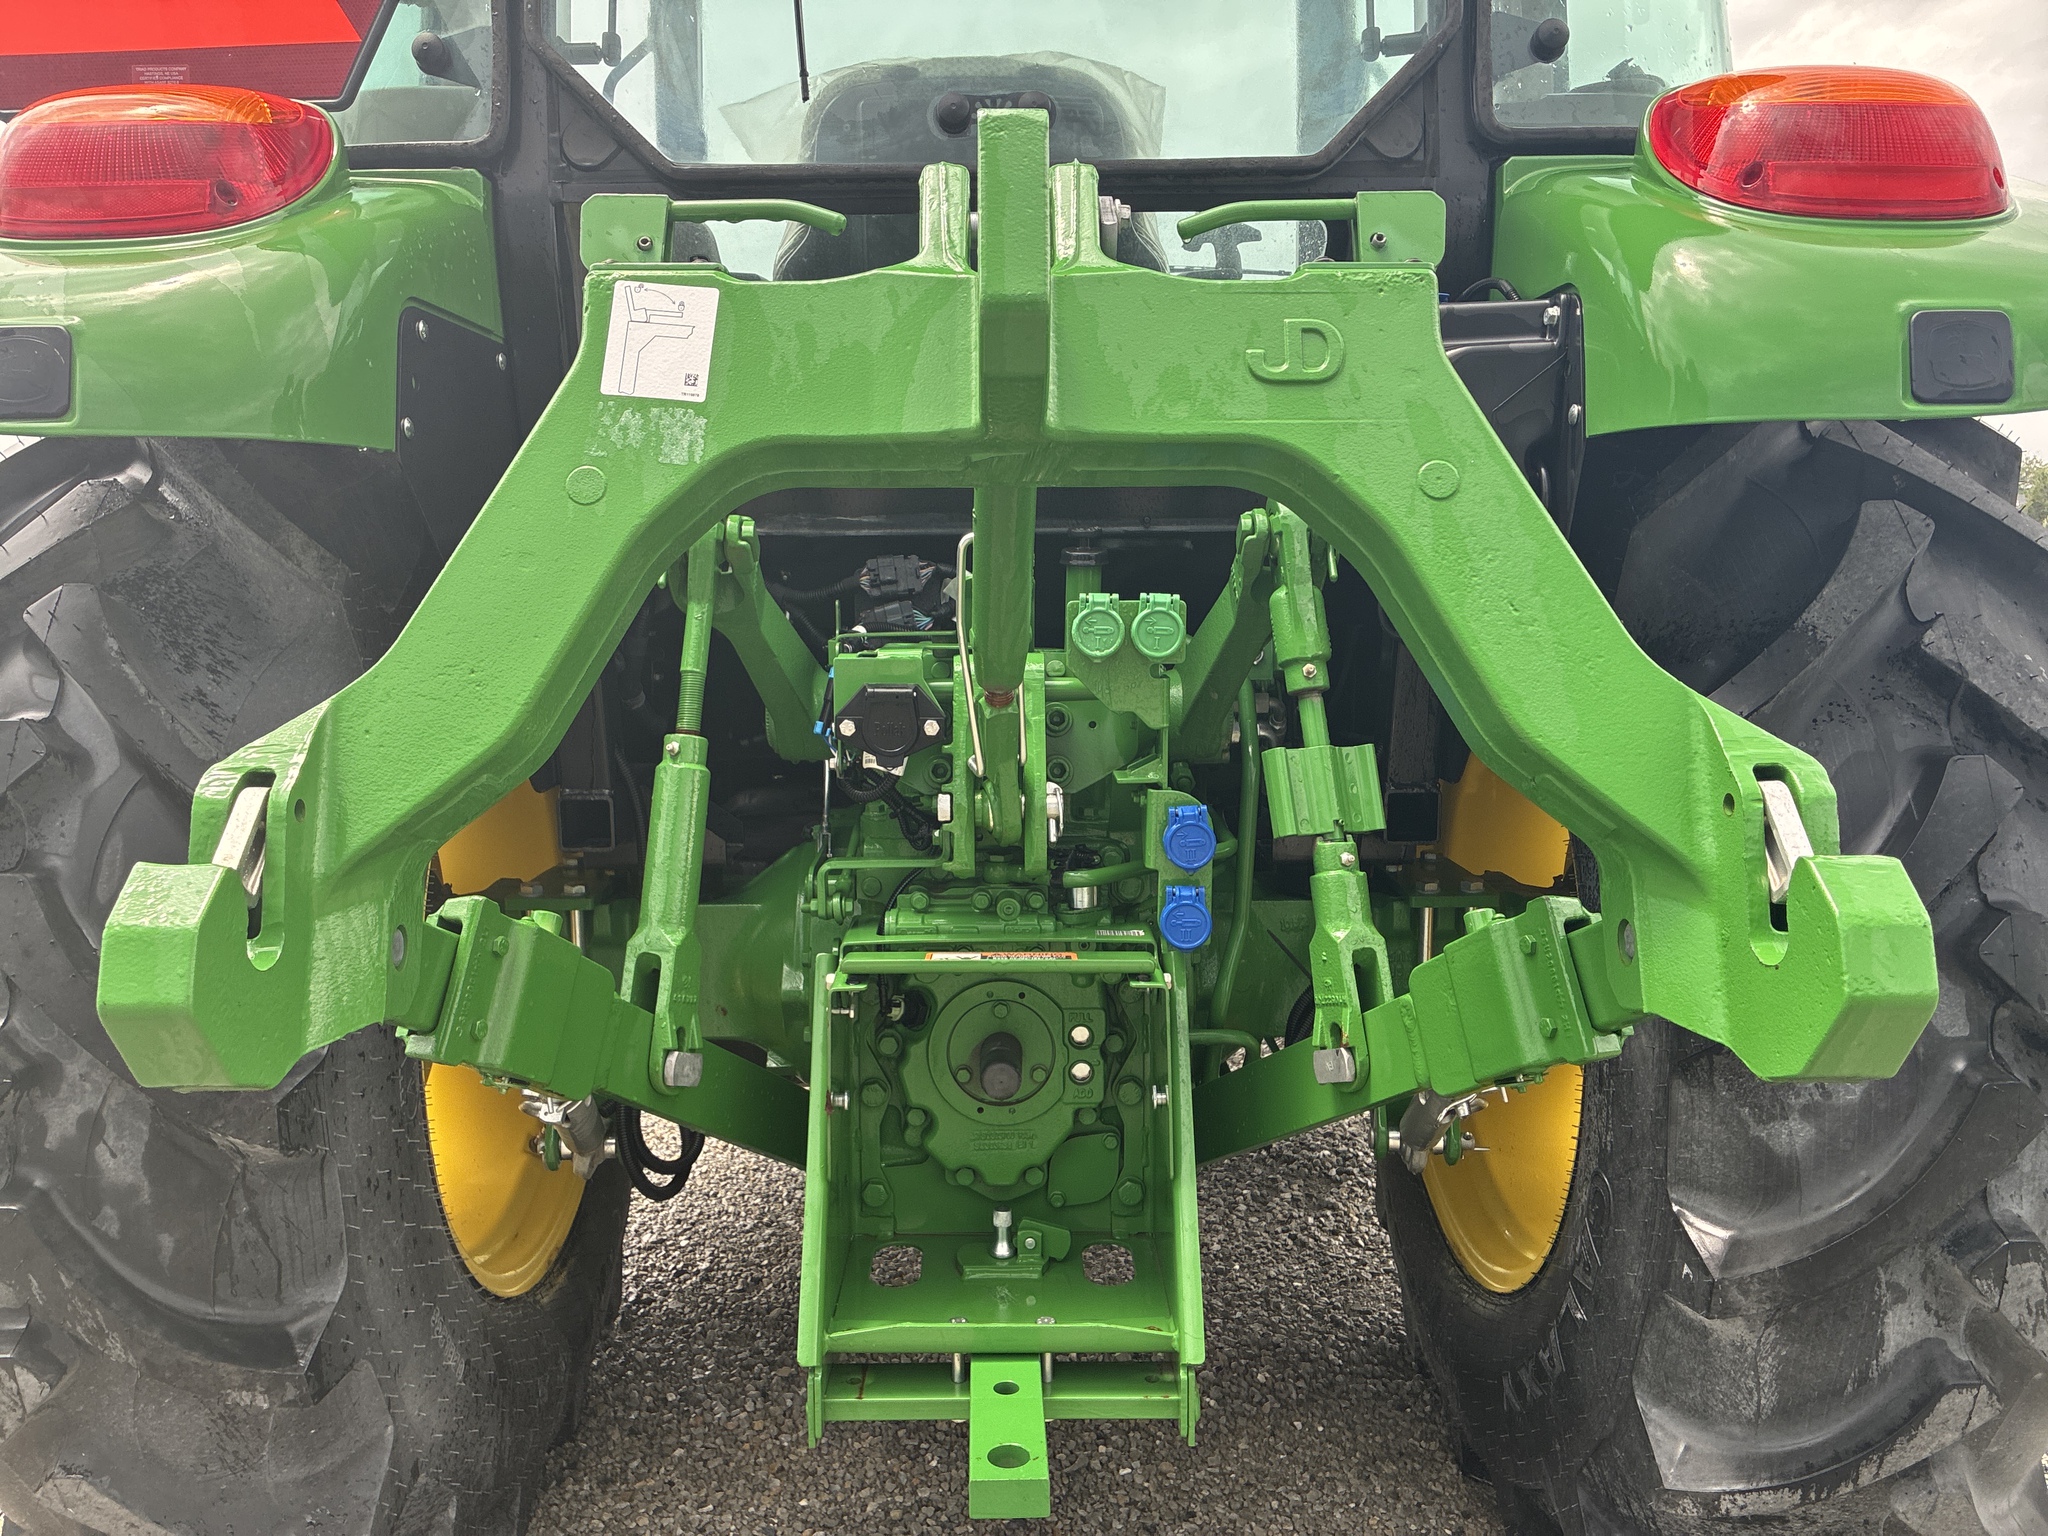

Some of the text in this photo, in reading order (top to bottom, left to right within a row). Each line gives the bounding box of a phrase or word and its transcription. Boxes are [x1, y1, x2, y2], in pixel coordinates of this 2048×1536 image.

[1245, 318, 1345, 384] JD
[1069, 1012, 1094, 1022] FULL
[1073, 1088, 1094, 1099] ADD
